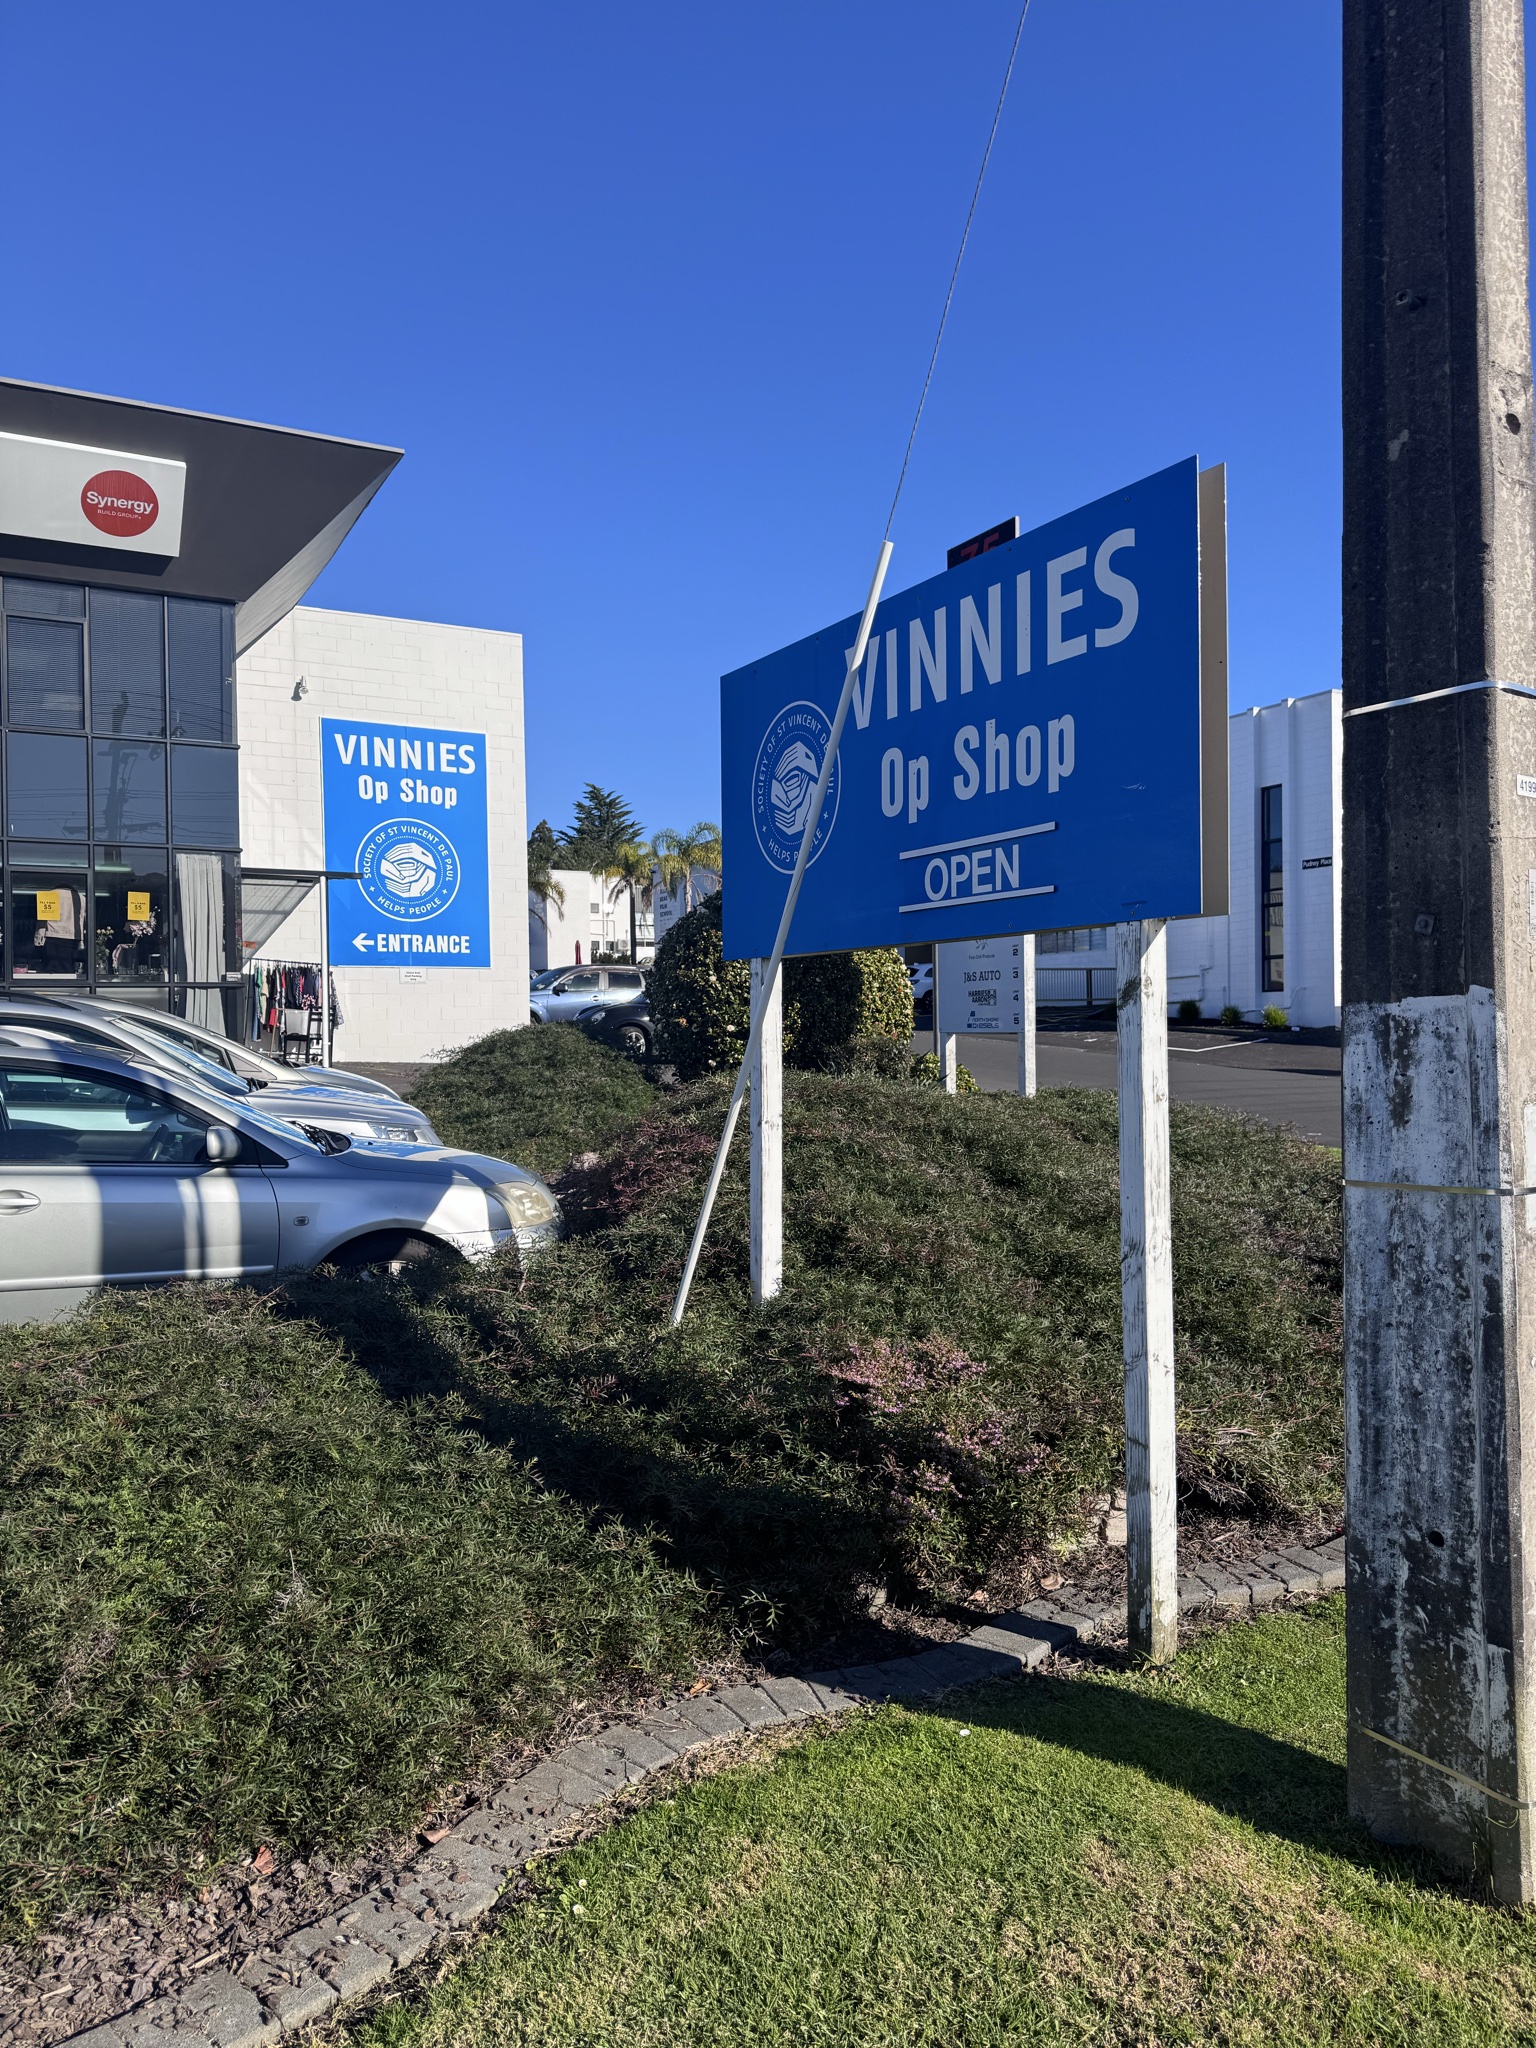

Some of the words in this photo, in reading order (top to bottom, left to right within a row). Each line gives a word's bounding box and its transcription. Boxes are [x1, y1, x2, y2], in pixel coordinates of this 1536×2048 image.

[86, 491, 154, 514] Synergy
[844, 527, 1139, 731] VINNIES
[334, 733, 476, 775] VINNIES
[757, 756, 769, 814] SOCIETY
[767, 735, 776, 753] OF
[777, 721, 786, 737] ST
[788, 714, 822, 734] VINCENT
[881, 747, 929, 824] Op
[953, 714, 1075, 800] Shop
[358, 774, 389, 804] Op
[399, 778, 457, 810] Shop
[363, 843, 377, 879] SOCIETY
[375, 832, 386, 843] OF
[387, 826, 399, 836] ST
[401, 825, 440, 844] VINCENT
[437, 844, 449, 857] DE
[444, 858, 454, 881] PAUL
[768, 838, 791, 862] HELPS
[924, 844, 1020, 901] OPEN
[377, 895, 405, 914] HELPS
[409, 897, 442, 915] PEOPLE
[377, 933, 470, 954] ENTRANCE
[1013, 948, 1019, 956] 2
[963, 971, 977, 983] J&S
[979, 970, 1001, 981] AUTO
[1013, 971, 1019, 979] 3
[1014, 1017, 1020, 1025] 5
